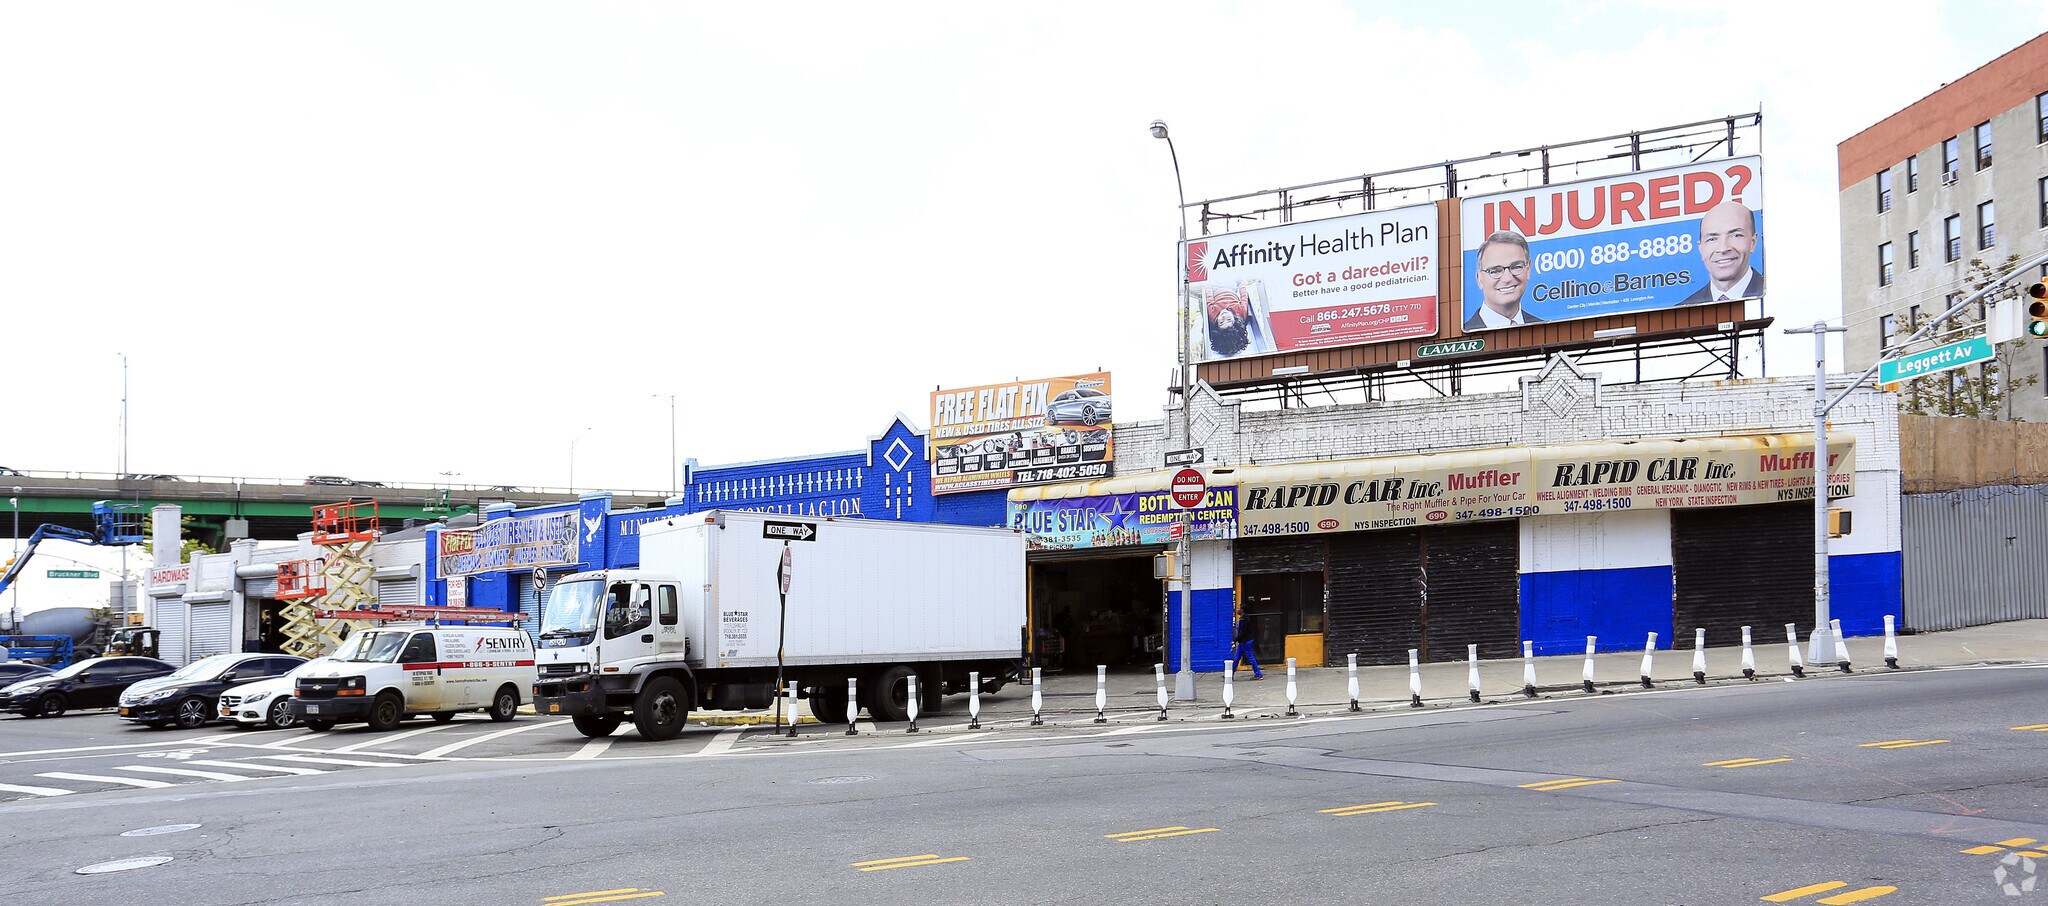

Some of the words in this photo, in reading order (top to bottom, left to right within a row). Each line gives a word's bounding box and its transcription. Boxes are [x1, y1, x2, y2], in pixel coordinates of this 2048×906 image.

[1483, 164, 1752, 240] INJURED?
[1212, 242, 1295, 269] Affinity
[1300, 227, 1374, 257] Health
[1381, 222, 1428, 246] Plan
[1534, 248, 1585, 274] (800)
[1590, 233, 1693, 265] 888-8888
[1293, 271, 1321, 287] Got
[1327, 271, 1336, 282] a
[1342, 256, 1429, 281] daredevil?
[1293, 287, 1318, 298] Better
[1321, 284, 1340, 294] have
[1350, 280, 1373, 292] good
[1375, 274, 1429, 289] pediatrician.
[1300, 315, 1315, 324] Call
[1317, 303, 1390, 322] 866.247.5678
[1392, 304, 1407, 313] (TTY
[1423, 341, 1478, 356] LAMAR
[1897, 350, 1951, 374] Leggett
[1953, 345, 1972, 360] Av
[934, 391, 974, 427] FREE
[977, 386, 1018, 422] FLAT
[1020, 382, 1050, 417] FIX
[935, 426, 954, 438] NEW
[956, 426, 962, 436] &
[964, 424, 985, 435] USED
[986, 420, 1010, 434] TIRES
[1011, 418, 1025, 430] ALL
[1027, 416, 1046, 428] SIZE
[1552, 460, 1641, 487] RAPID
[1647, 456, 1699, 482] CAR
[1760, 451, 1838, 472] Mufflr
[990, 470, 1011, 478] WHEELS
[1448, 470, 1520, 490] Muffler
[1727, 482, 1738, 491] NEW
[1739, 481, 1751, 490] RIMS
[1752, 481, 1756, 489] &
[1757, 480, 1769, 489] NEW
[1770, 478, 1784, 488] TIRES
[1788, 477, 1806, 487] LIGHTS
[1807, 477, 1810, 485] &
[1206, 490, 1233, 508] CAN
[1244, 482, 1340, 511] RAPID
[1344, 477, 1404, 504] CAR
[1536, 490, 1555, 501] WHEEL
[1557, 489, 1588, 500] ALIGNMENT
[1593, 487, 1617, 498] WELDING
[1618, 486, 1632, 496] RIMS
[1637, 485, 1660, 495] GENERAL
[1661, 483, 1688, 494] MECHANIC
[1778, 488, 1794, 500] NYS
[1386, 503, 1400, 512] The
[1402, 501, 1422, 512] Right
[1424, 498, 1450, 509] Muffler
[1460, 496, 1476, 507] Pipe
[1478, 494, 1491, 503] For
[1492, 493, 1511, 502] Your
[1512, 491, 1526, 500] Car
[1564, 497, 1631, 512] 347-498-1500
[1655, 498, 1667, 507] NEW
[1669, 497, 1684, 506] YORK
[1688, 495, 1704, 505] STATE
[1705, 494, 1737, 504] INSPECTION
[1014, 510, 1053, 534] BLUE
[1058, 507, 1097, 532] STAR
[1197, 509, 1233, 520] CENTER
[1354, 521, 1370, 529] NYS
[1371, 517, 1416, 528] INSPECTION
[503, 521, 522, 546] TIRES
[524, 519, 538, 543] NEW
[546, 516, 564, 541] USED
[770, 526, 786, 534] ONE
[792, 527, 809, 535] WAY
[1244, 521, 1310, 536] 347-498-1500
[153, 568, 189, 584] HARDWARE
[486, 638, 526, 649] SENTRY
